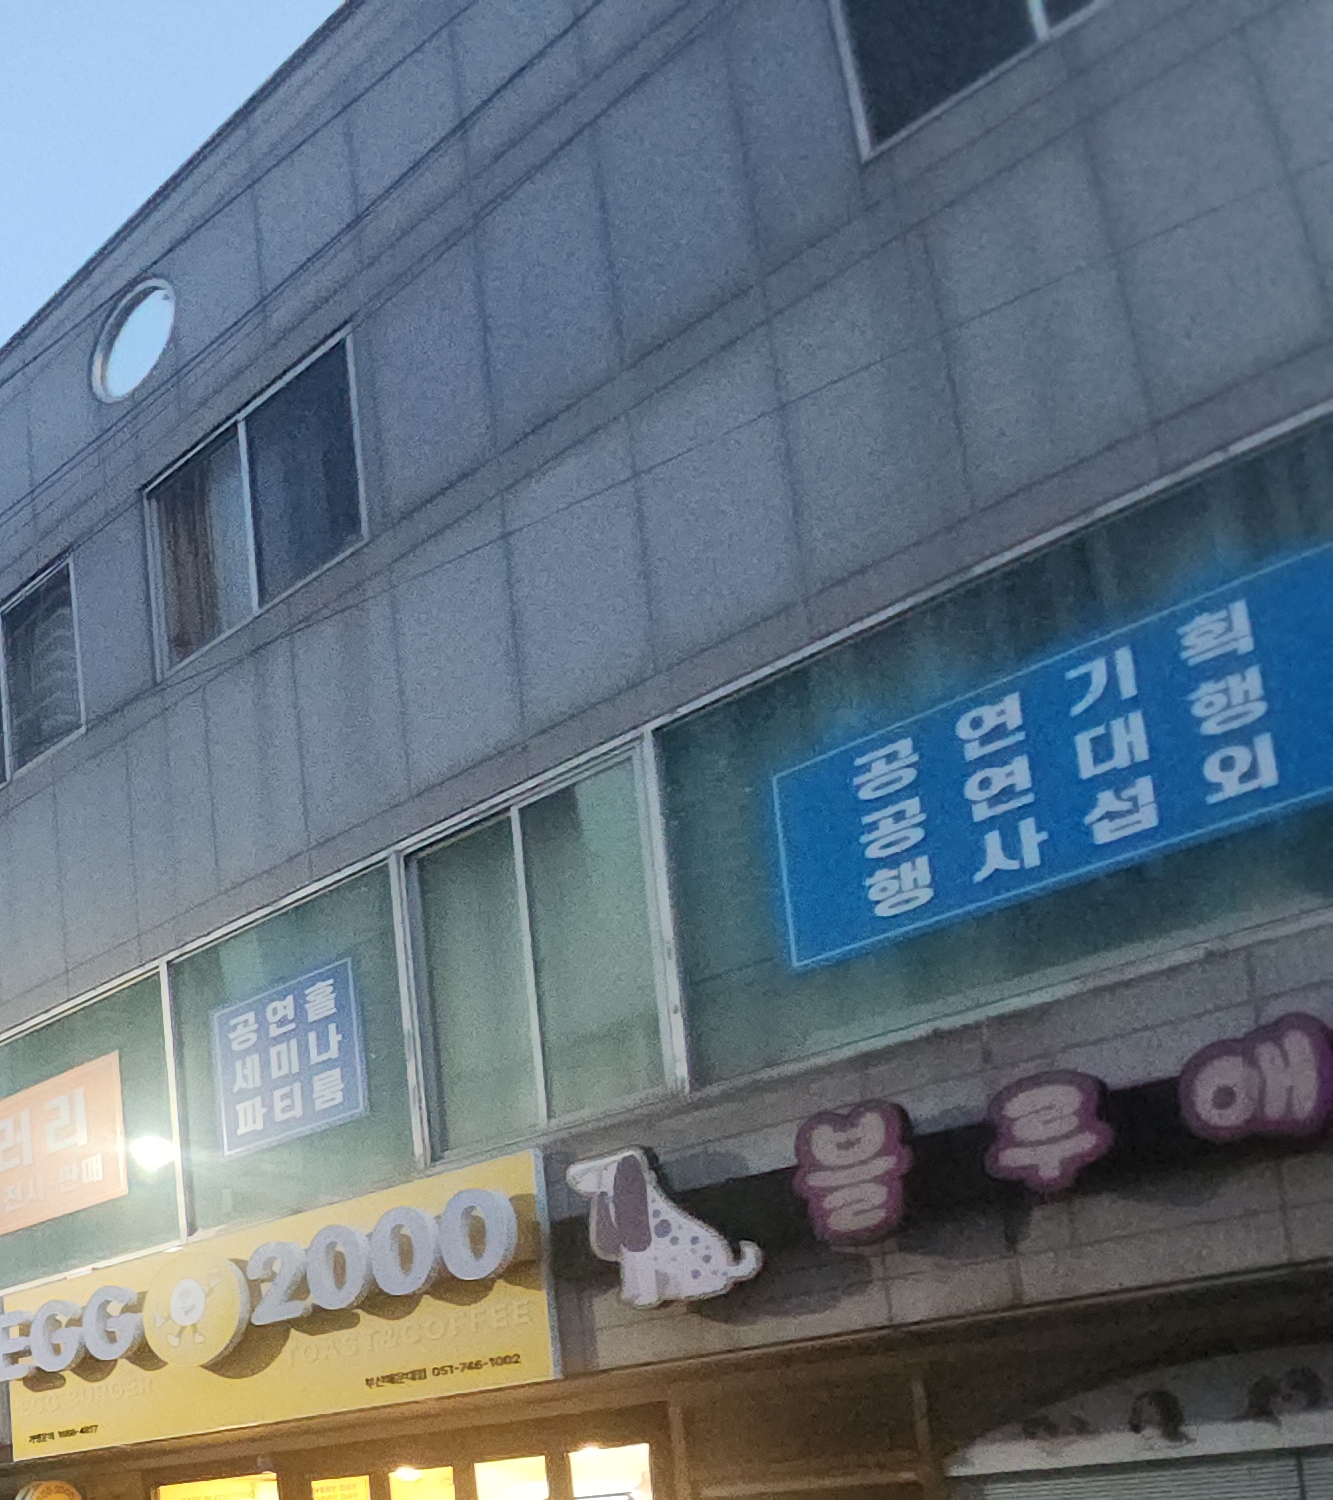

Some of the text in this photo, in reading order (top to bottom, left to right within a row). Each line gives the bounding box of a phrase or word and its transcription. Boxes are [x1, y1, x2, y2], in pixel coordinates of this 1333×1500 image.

[227, 978, 338, 1051] 공연홀
[233, 1022, 343, 1093] 세미나
[236, 1066, 345, 1136] 파티룸
[246, 1186, 521, 1327] 2000
